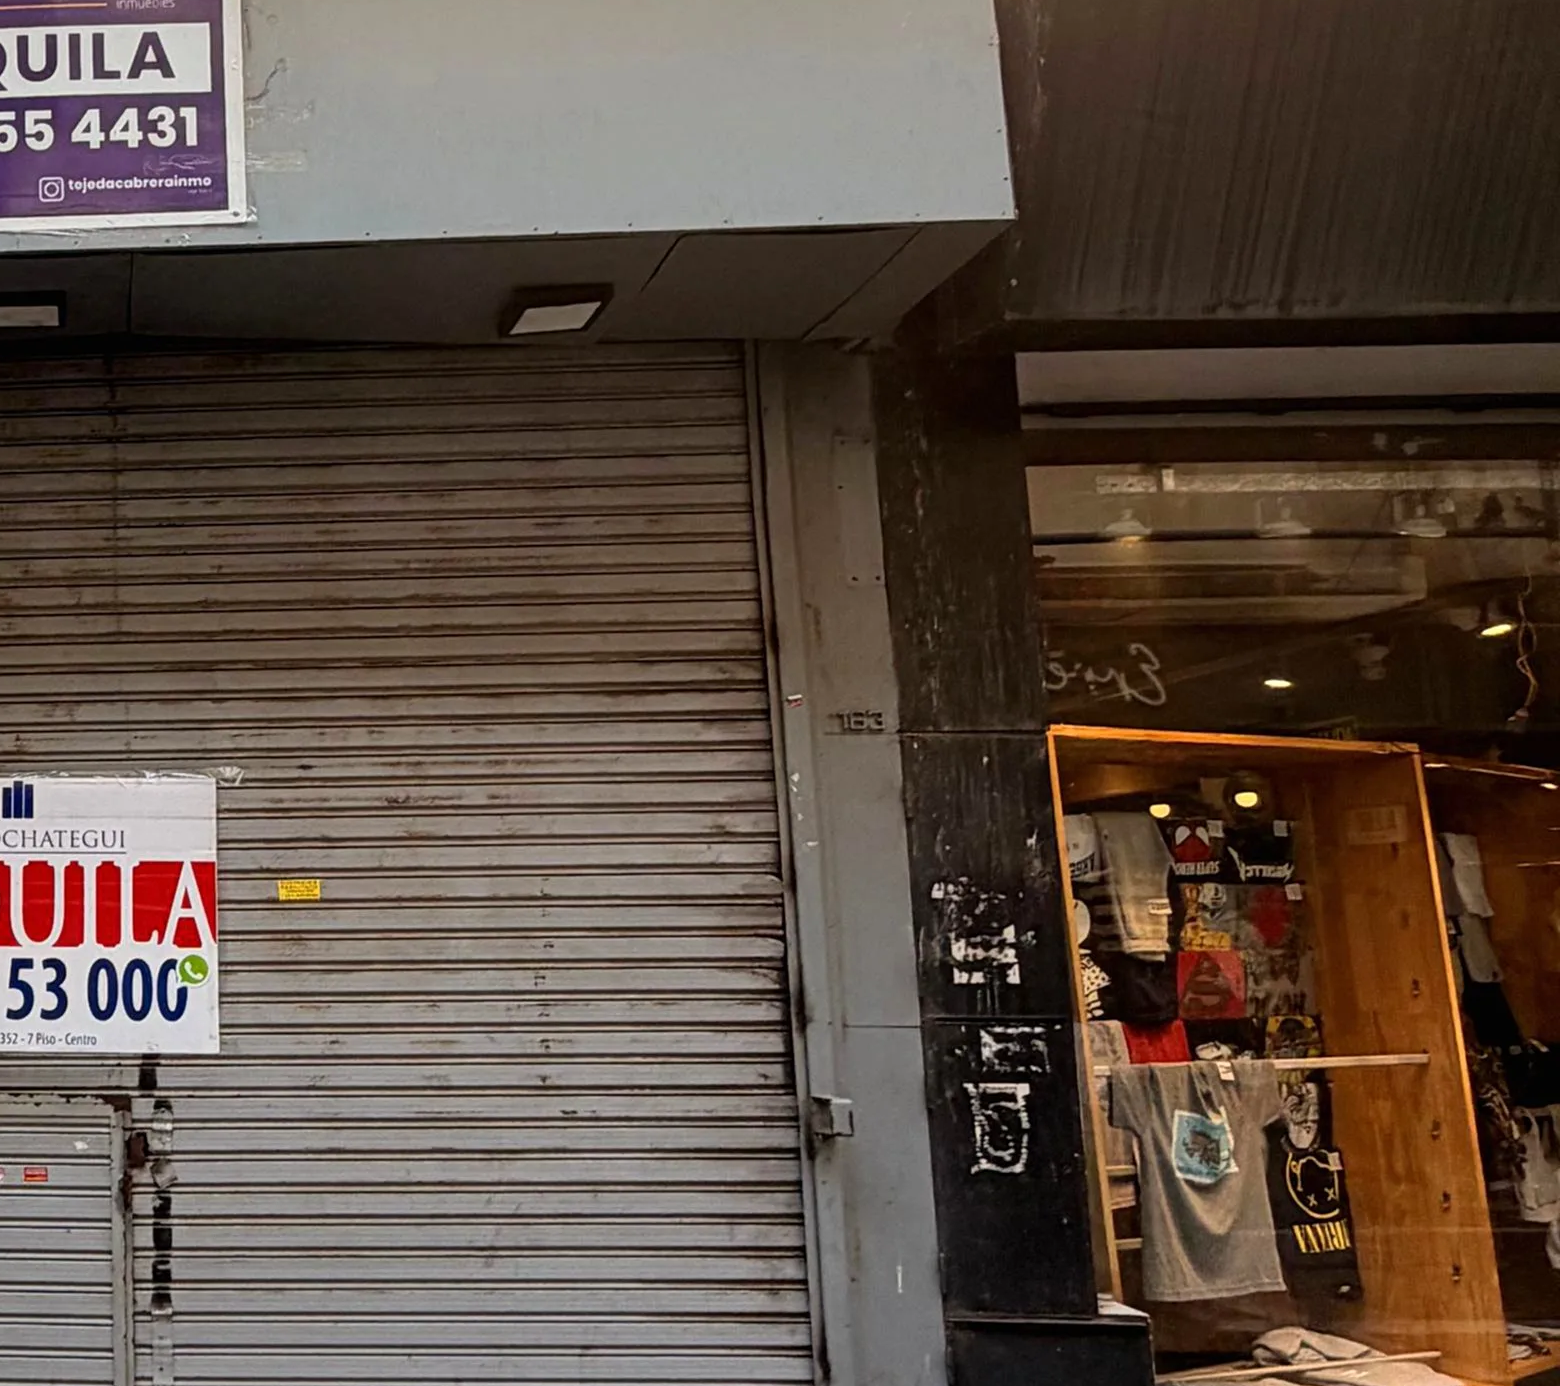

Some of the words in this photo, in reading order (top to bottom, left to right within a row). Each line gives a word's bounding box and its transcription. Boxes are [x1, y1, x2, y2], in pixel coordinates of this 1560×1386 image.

[71, 106, 198, 149] 4431
[6, 958, 68, 1021] 53
[87, 958, 189, 1022] 000
[0, 1033, 18, 1045] 352
[27, 1033, 33, 1044] 7
[36, 1032, 56, 1045] Piso
[65, 1032, 97, 1045] Centro
